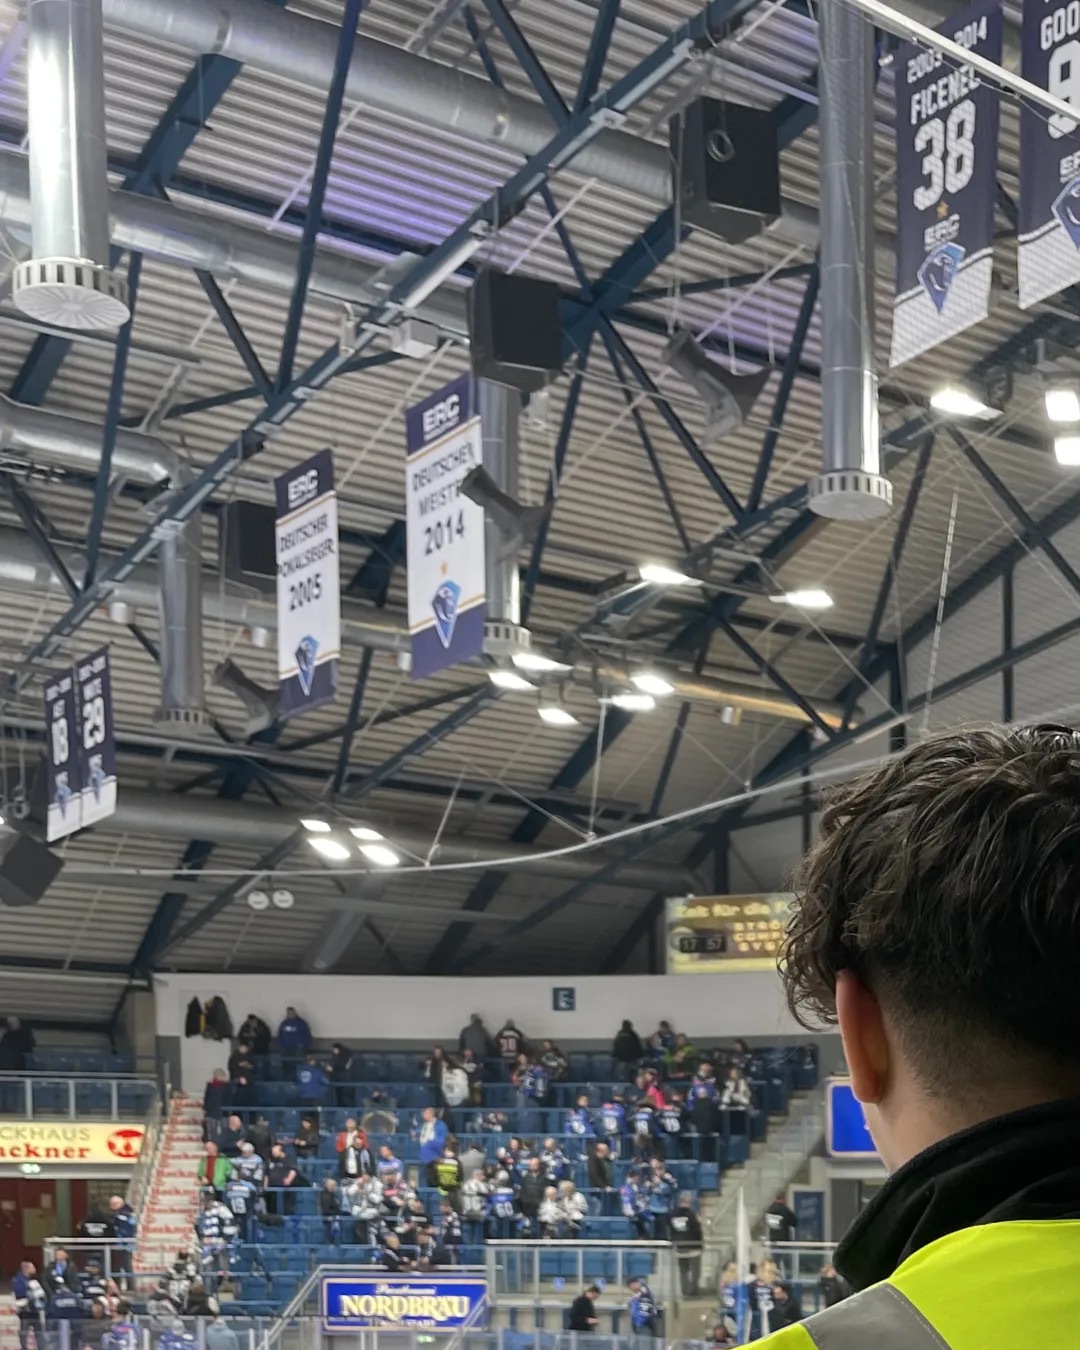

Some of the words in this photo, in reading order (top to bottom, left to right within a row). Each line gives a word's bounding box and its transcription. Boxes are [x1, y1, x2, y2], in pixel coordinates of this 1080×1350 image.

[913, 99, 976, 211] 38
[423, 394, 460, 432] ERC
[288, 469, 318, 500] ERC
[425, 510, 464, 556] 2014
